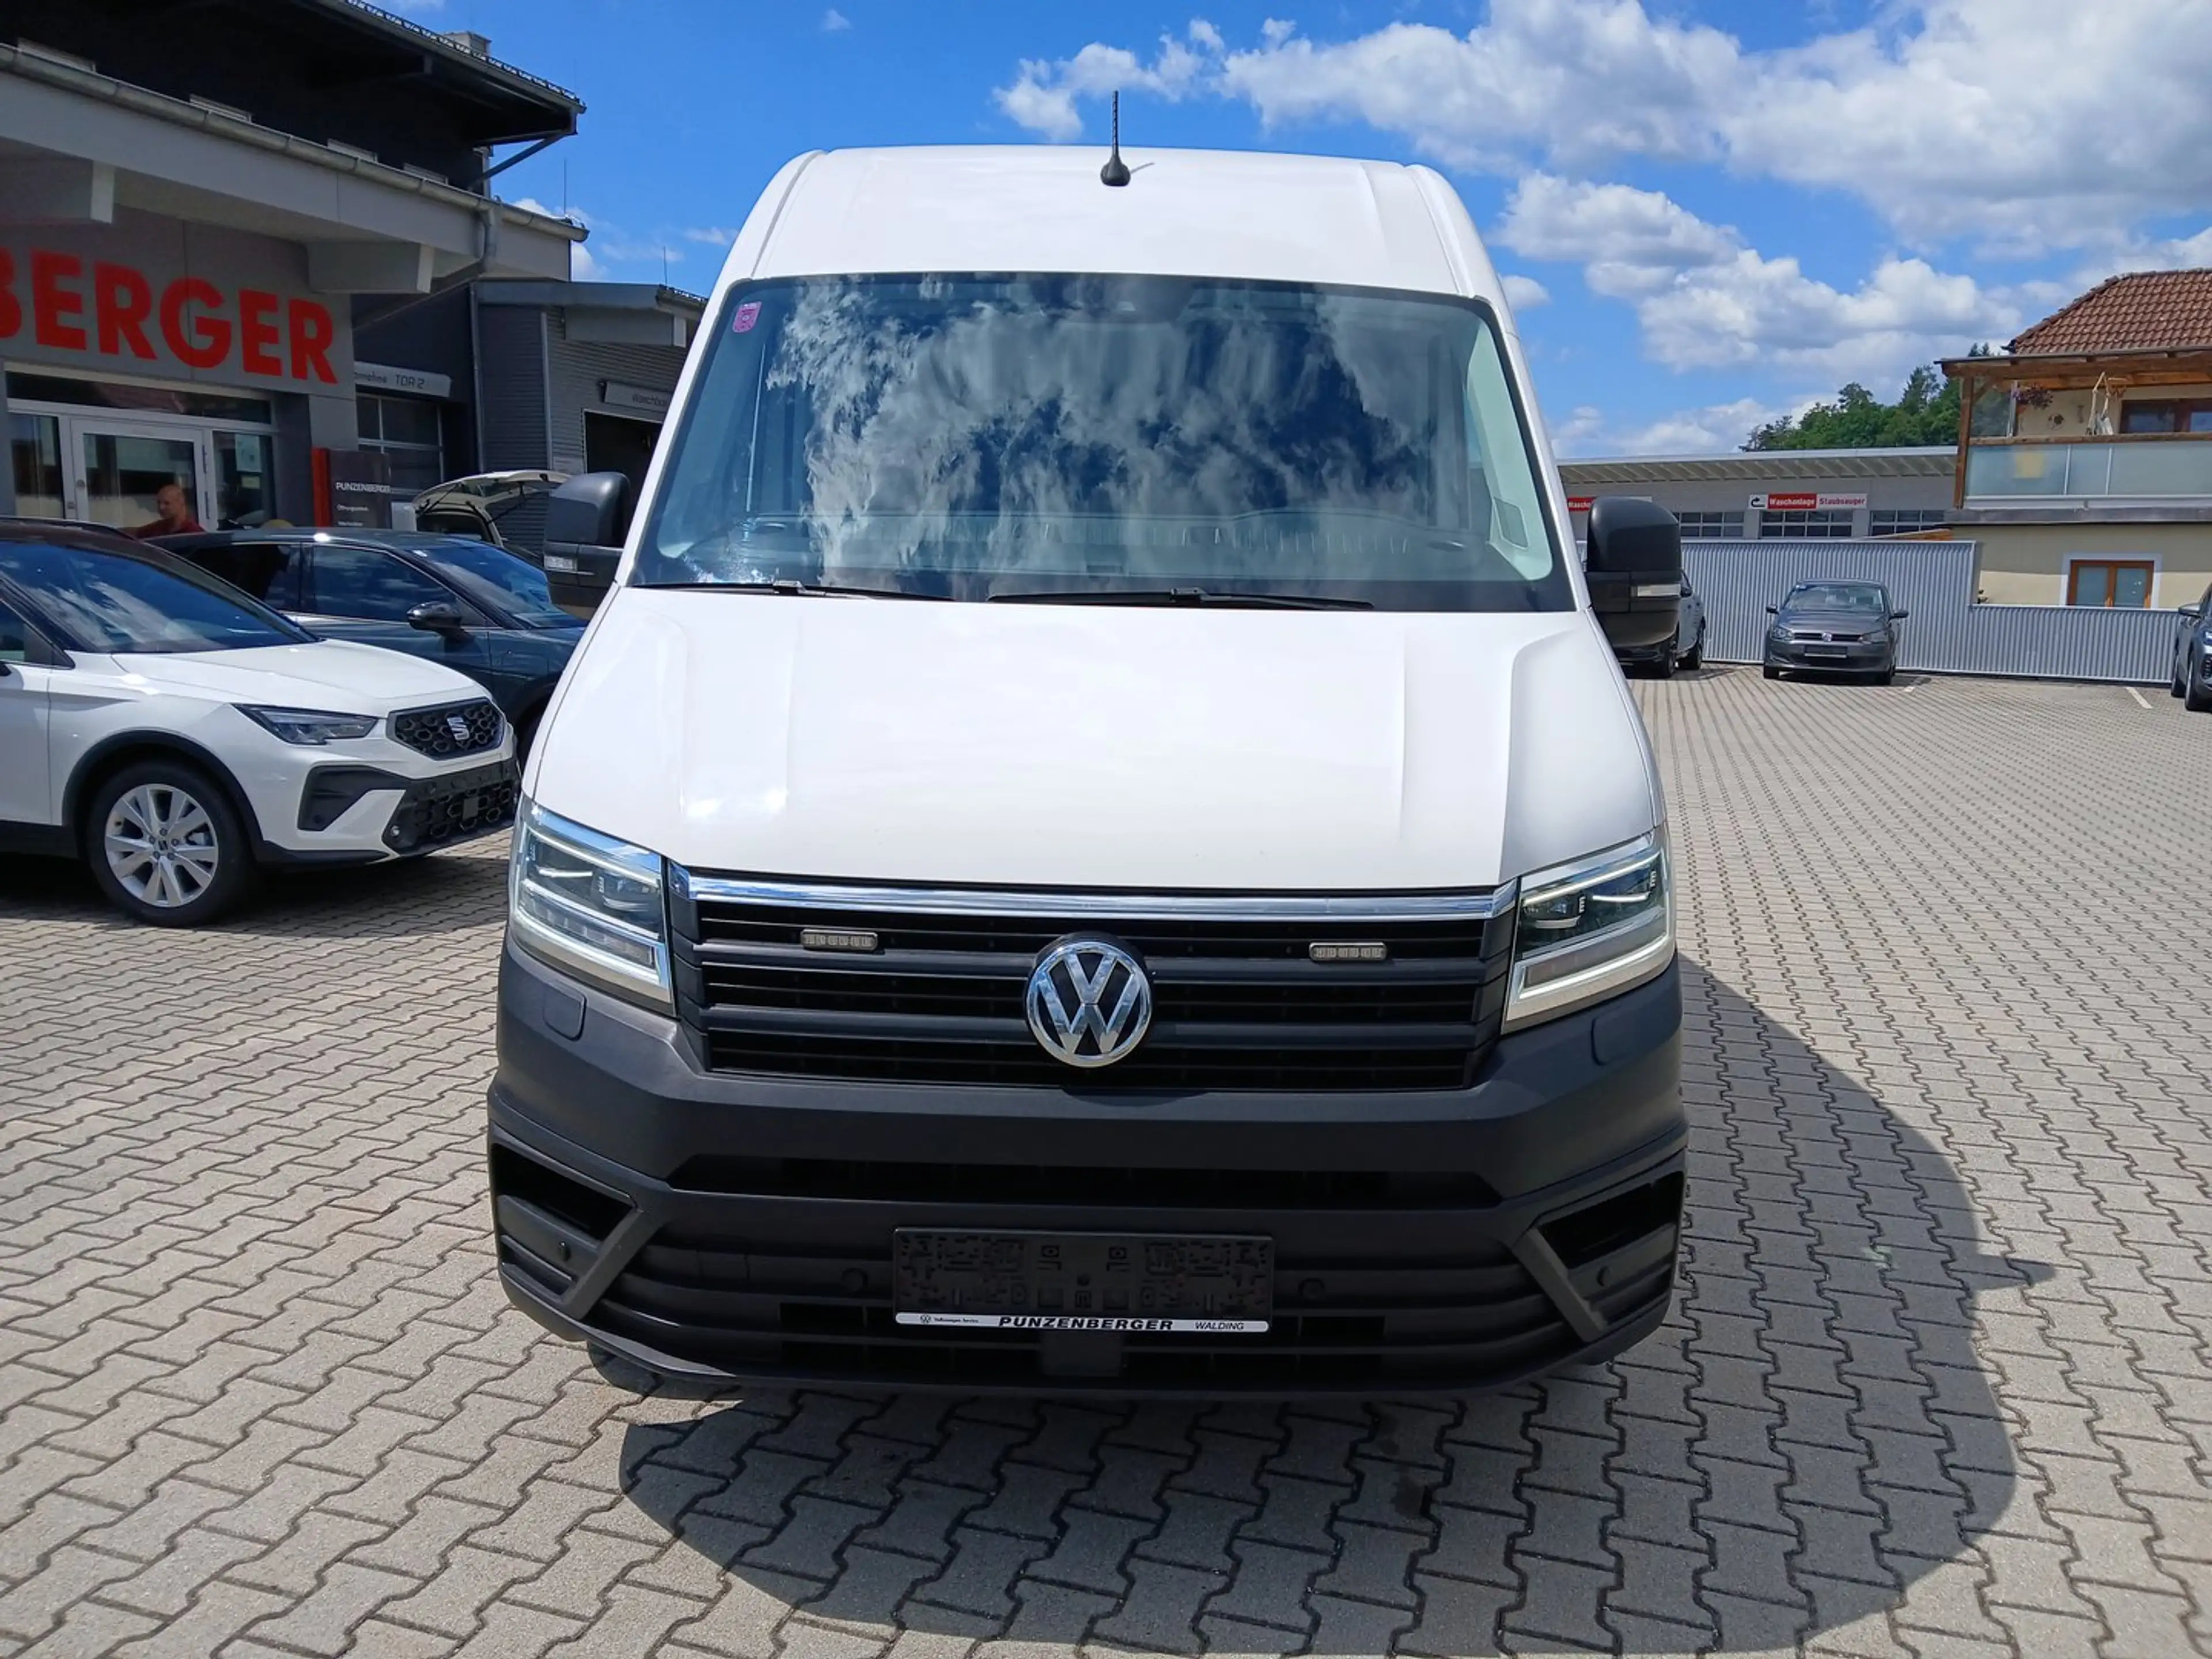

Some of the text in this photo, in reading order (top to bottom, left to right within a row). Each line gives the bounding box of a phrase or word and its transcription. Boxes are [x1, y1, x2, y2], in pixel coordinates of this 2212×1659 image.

[1770, 497, 1866, 507] Waschanlage Staubsauger
[998, 1316, 1174, 1331] PUNZENBERGER
[1194, 1320, 1245, 1331] WALDING
